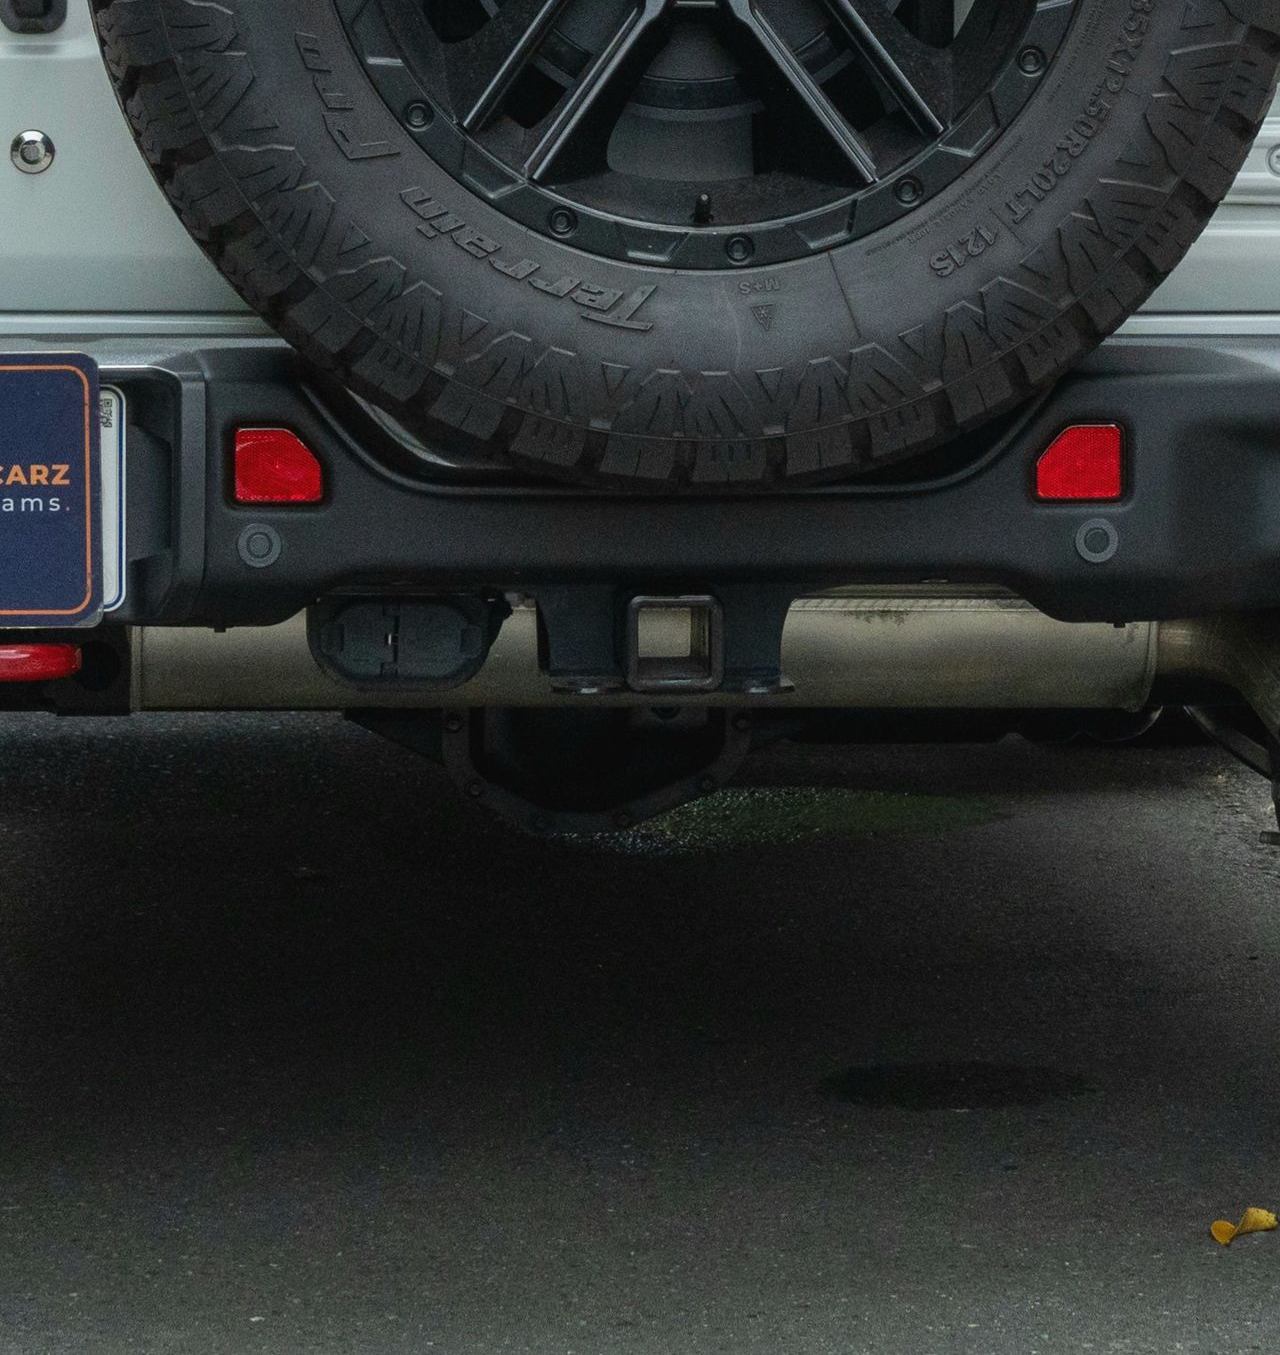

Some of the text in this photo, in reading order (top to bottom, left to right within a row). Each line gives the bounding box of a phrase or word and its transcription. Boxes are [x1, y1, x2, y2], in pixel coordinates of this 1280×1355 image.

[293, 31, 658, 331] Terrain Pro
[928, 225, 1000, 278] 121S
[737, 275, 782, 296] M+S
